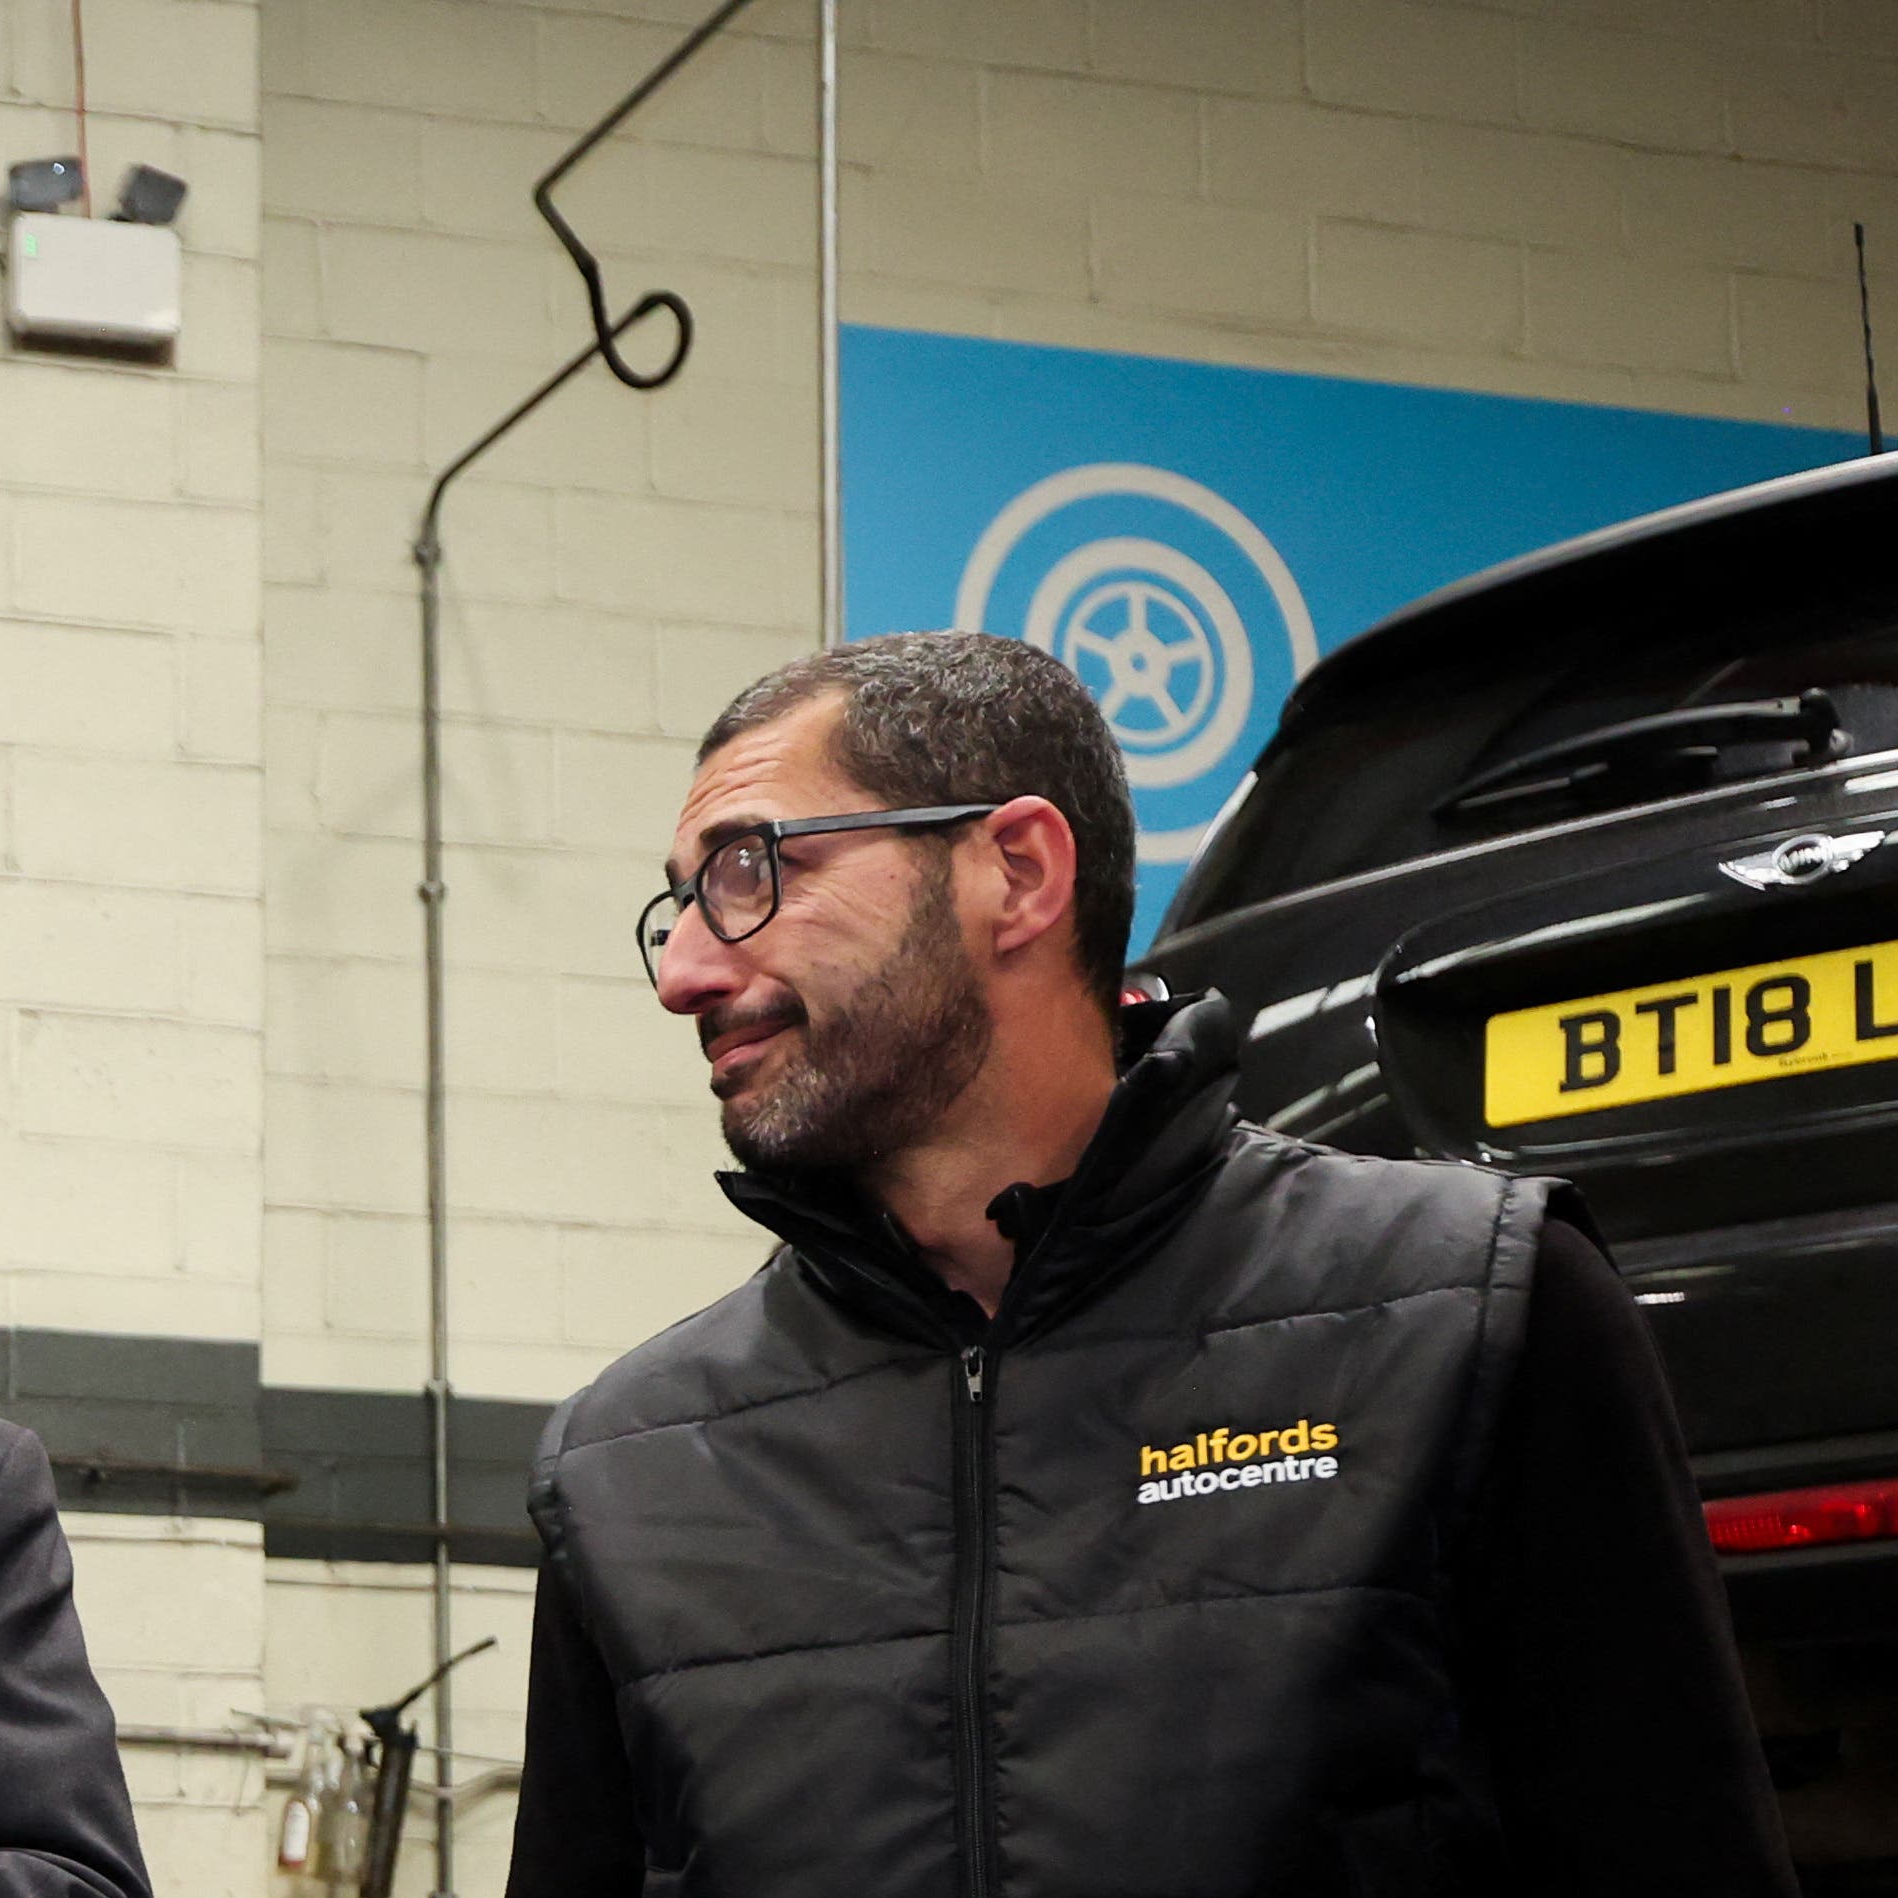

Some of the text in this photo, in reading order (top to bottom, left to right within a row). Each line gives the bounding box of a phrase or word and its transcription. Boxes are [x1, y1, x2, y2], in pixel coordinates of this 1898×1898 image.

[1558, 973, 1812, 1094] BT18
[1139, 1418, 1339, 1477] halfords
[1136, 1455, 1339, 1505] autocentre
